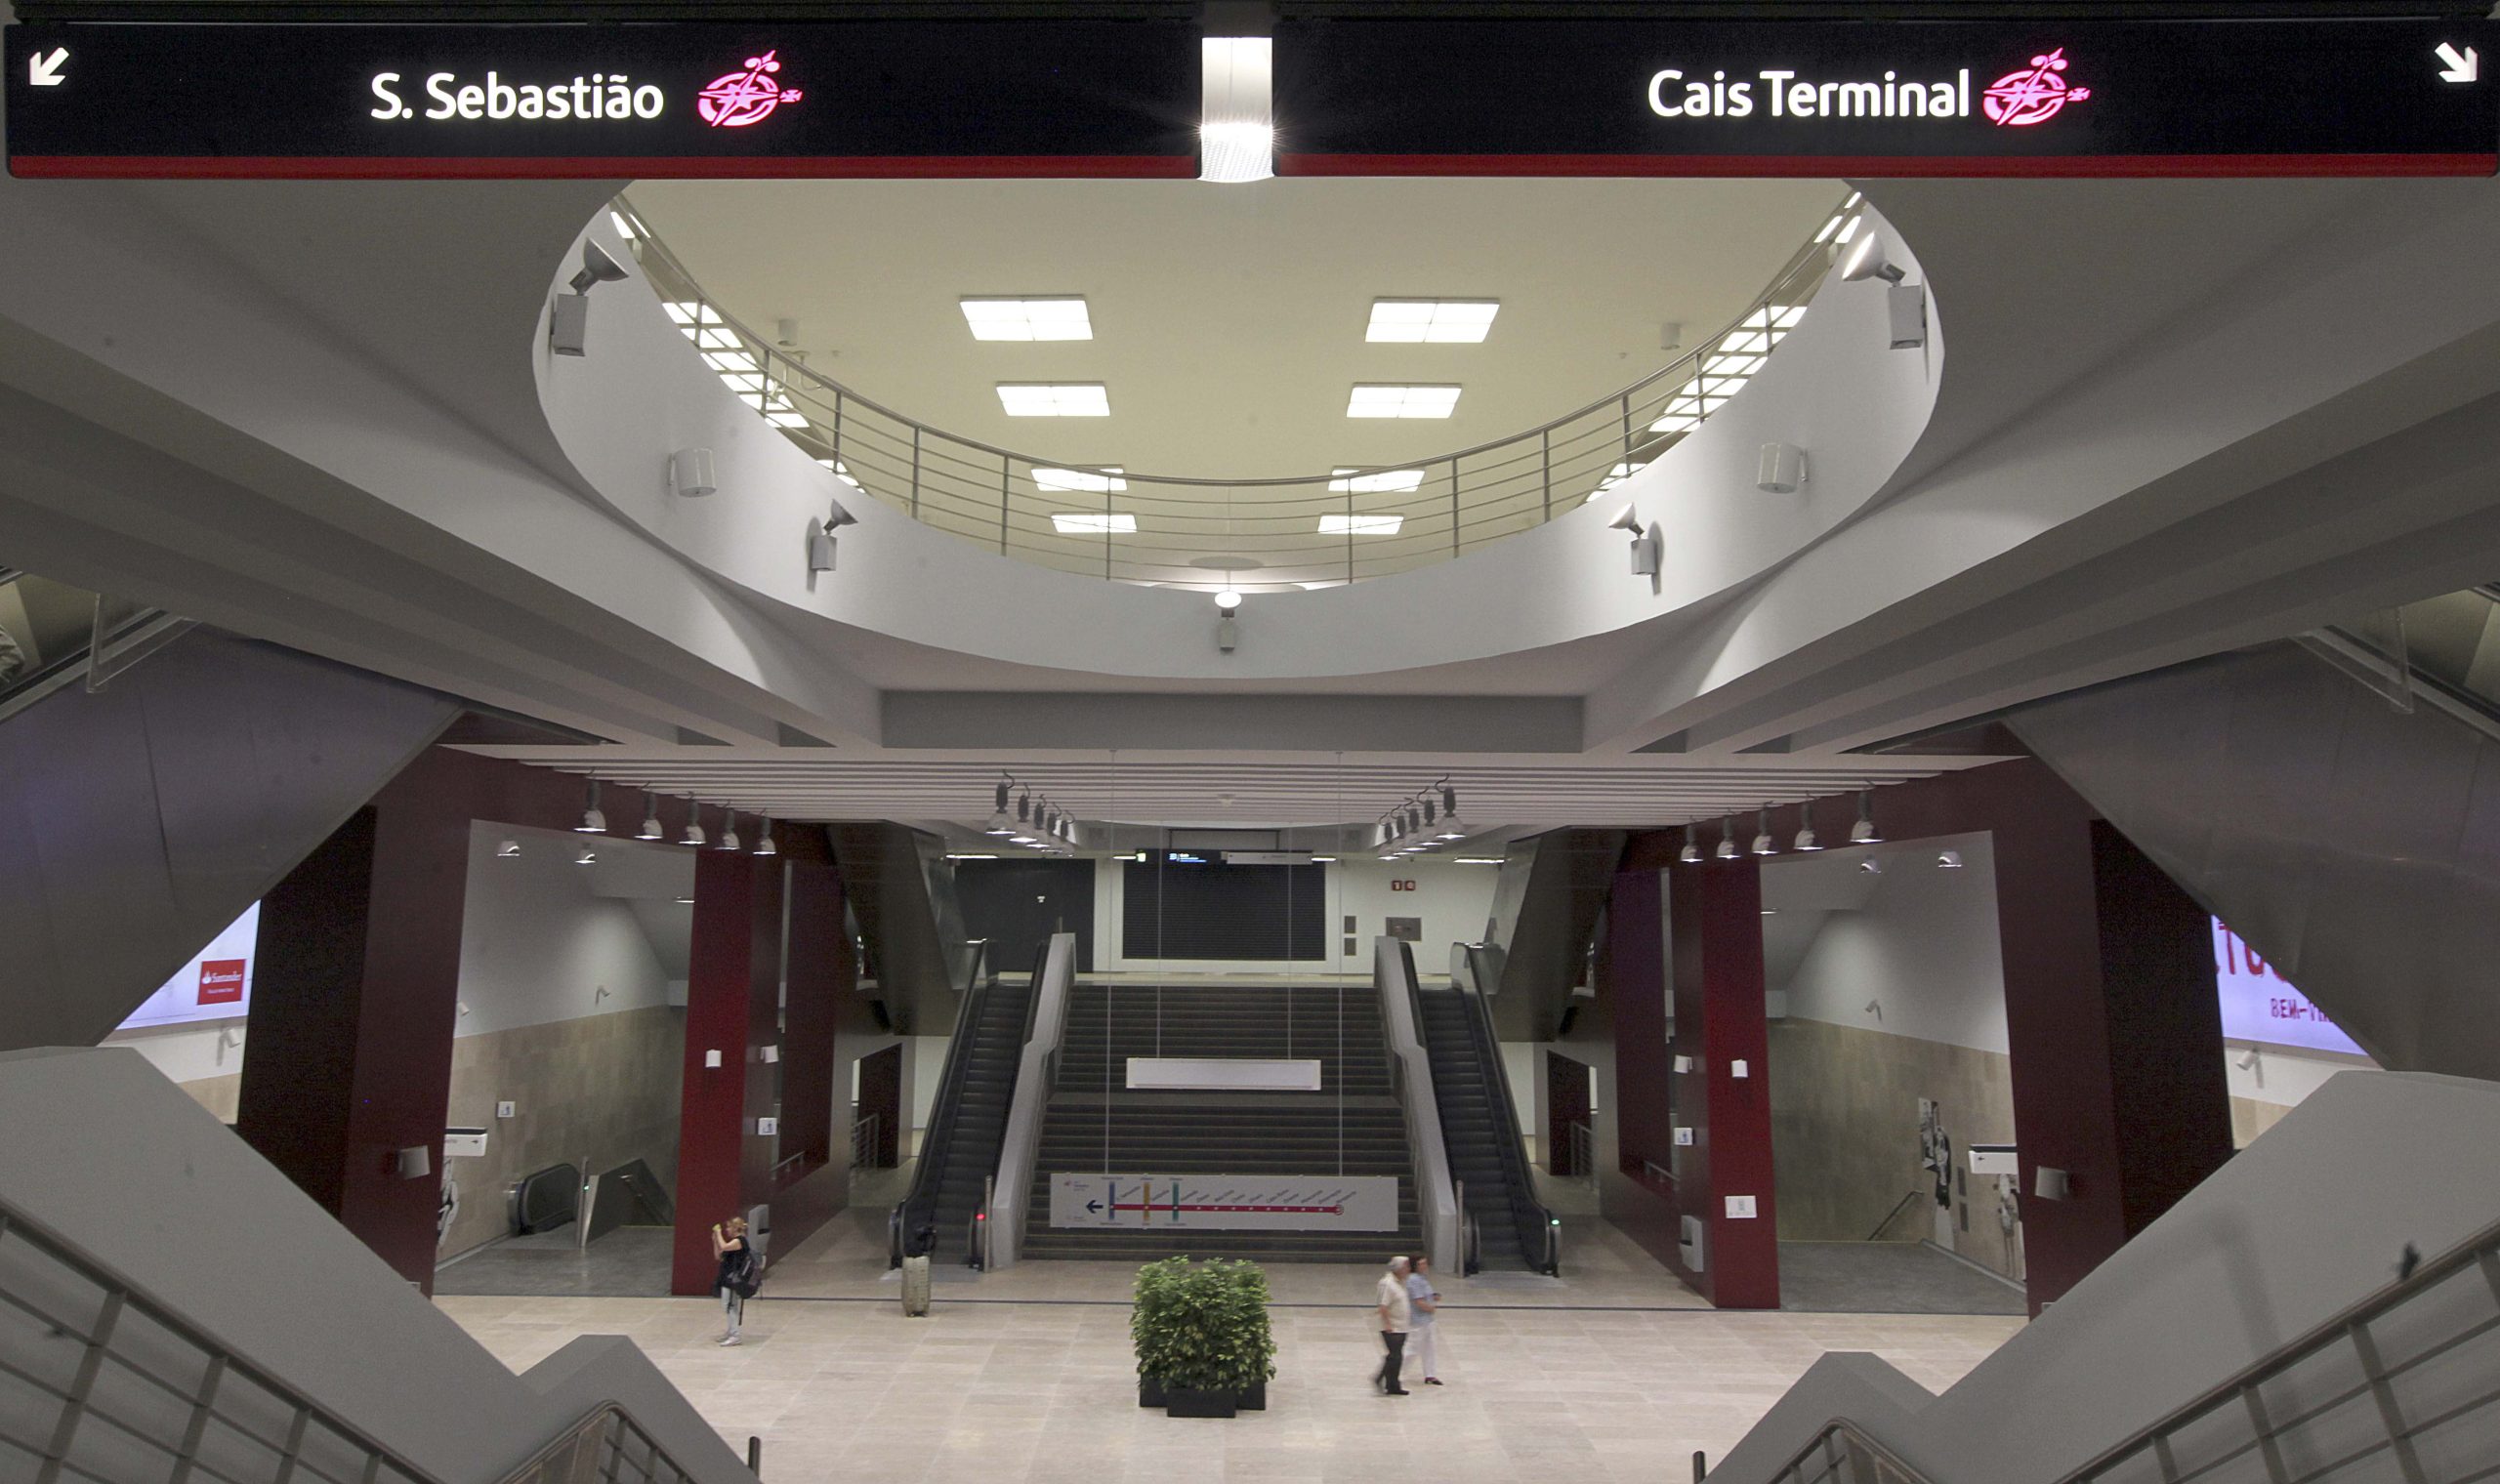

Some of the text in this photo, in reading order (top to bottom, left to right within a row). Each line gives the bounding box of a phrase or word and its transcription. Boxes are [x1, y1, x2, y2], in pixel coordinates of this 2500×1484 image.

[370, 70, 664, 119] S. Sebastião
[1647, 68, 1970, 117] Cais Terminal
